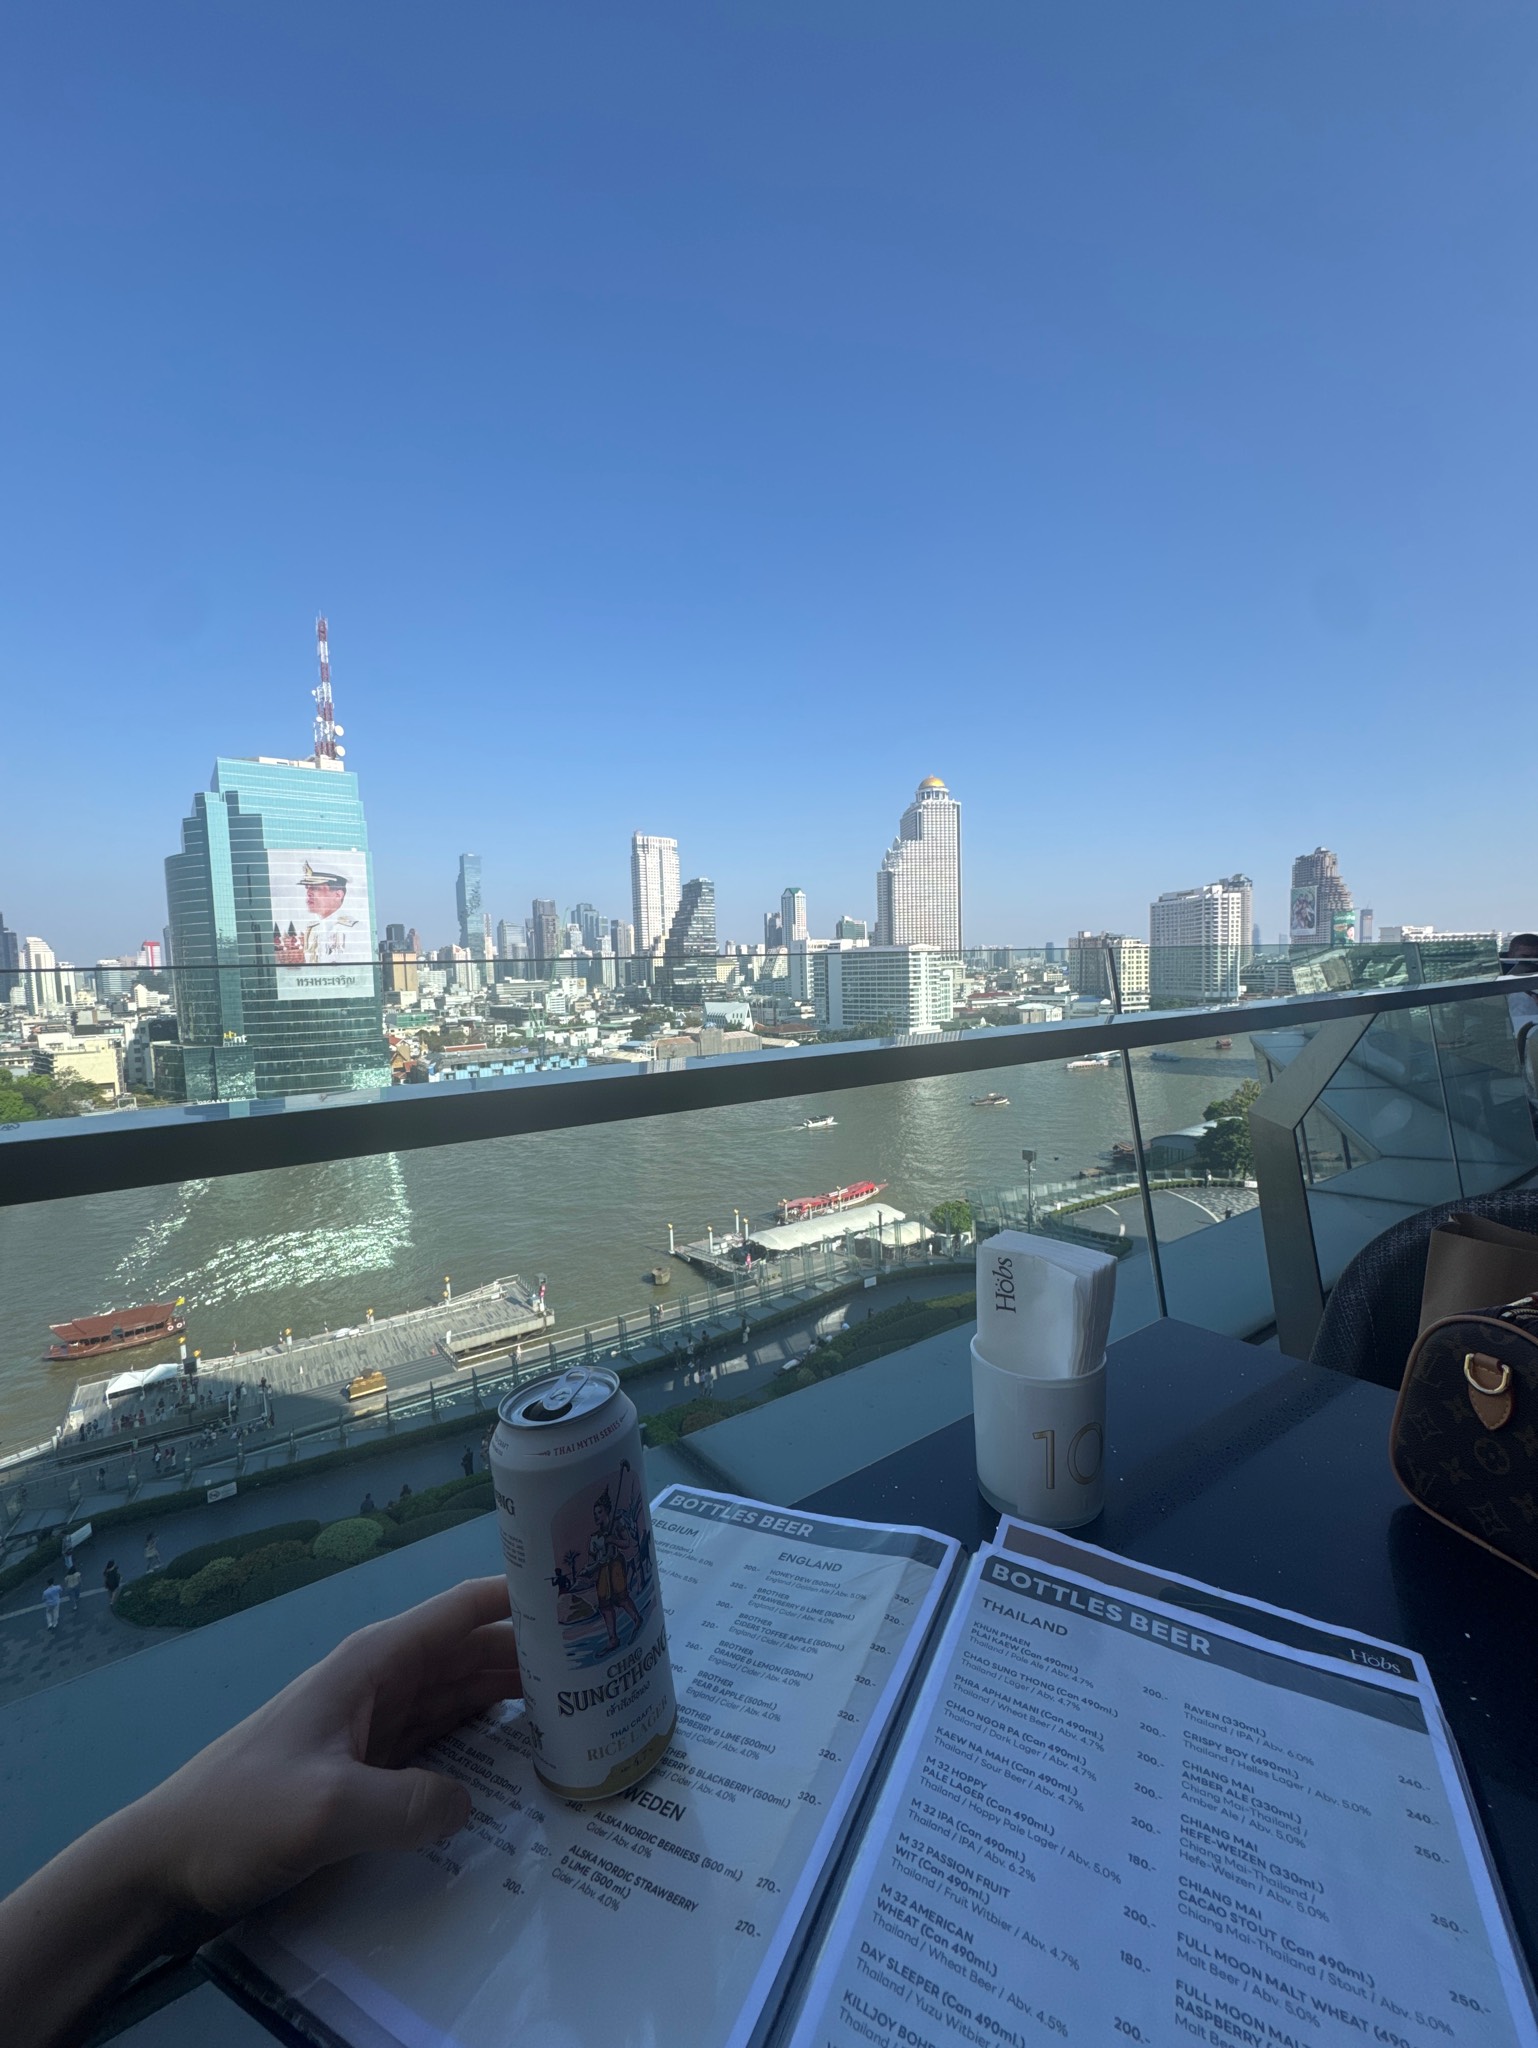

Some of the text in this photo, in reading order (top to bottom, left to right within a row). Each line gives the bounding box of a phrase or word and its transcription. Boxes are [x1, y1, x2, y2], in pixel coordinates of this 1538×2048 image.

[992, 1256, 1016, 1313] Höbs
[553, 1421, 621, 1456] THAI MYTH SERIES
[1032, 1421, 1104, 1490] 10
[651, 1518, 700, 1538] BELGIUM
[669, 1494, 814, 1538] BOTTLES BEER
[777, 1551, 843, 1572] ENGLAND
[972, 1620, 1031, 1648] KHUN PHAEN
[982, 1596, 1068, 1637] THAILAND
[991, 1563, 1211, 1656] BOTTLES BEER
[713, 1646, 747, 1663] ORANGE
[751, 1659, 782, 1673] LEMON
[779, 1666, 814, 1681] (500ml.)
[970, 1627, 1079, 1674] PLAI KAEW (Can 490ml.)
[1349, 1648, 1401, 1674] Höbs
[954, 1673, 1104, 1742] PHRA APHAI MANI (Can 490ml.)
[963, 1650, 1118, 1718] CHAO SUNG THONG (Can 490ml.)
[610, 1704, 653, 1739] THAI CRAFT
[945, 1699, 1087, 1767] CHAO NGOR PA (Can 490ml.)
[1183, 1701, 1267, 1738] RAVEN (330ml.)
[587, 1738, 626, 1761] RICE
[925, 1754, 988, 1790] M 32 HOPPY
[935, 1725, 1078, 1797] KAEW NA MAH (Can 490ml.)
[1181, 1759, 1255, 1794] CHIANG MAI
[1182, 1729, 1299, 1780] CRISPY BOY (490ml.)
[620, 1782, 687, 1822] WEDEN
[922, 1764, 1055, 1837] PALE LAGER (Can 490ml.)
[1181, 1770, 1302, 1825] AMBER ALE (330ml.)
[593, 1810, 743, 1882] ALSKA NORDIC BERRIESS (500 ml.)
[910, 1797, 1026, 1864] M 32 IPA (Can 490ml.)
[1179, 1813, 1258, 1853] CHIANG MAI
[566, 1858, 592, 1877] LIME
[589, 1869, 614, 1890] (500
[610, 1883, 632, 1899] ml.)
[568, 1844, 699, 1912] ALSKA NORDIC STRAWBERRY
[895, 1843, 990, 1905] WIT (Can 490ml.)
[898, 1831, 1011, 1898] M 32 PASSION FRUIT
[1179, 1823, 1324, 1894] HEFE-WEIZEN (330ml.)
[880, 1882, 974, 1945] M 32 AMERICAN
[1177, 1875, 1262, 1921] CHIANG MAI
[877, 1895, 998, 1978] WHEAT (Can 490ml.)
[1177, 1888, 1375, 1989] CACAO STOUT (Can 490ml.)
[860, 1940, 1026, 2048] DAY SLEEPER (Can 490ml.)
[1175, 1978, 1265, 2034] FULL MOON
[1176, 1930, 1367, 2033] FULL MOON MALT WHEAT
[843, 1989, 897, 2031] KILLJOY
[1175, 1995, 1262, 2048] RASPBERRY
